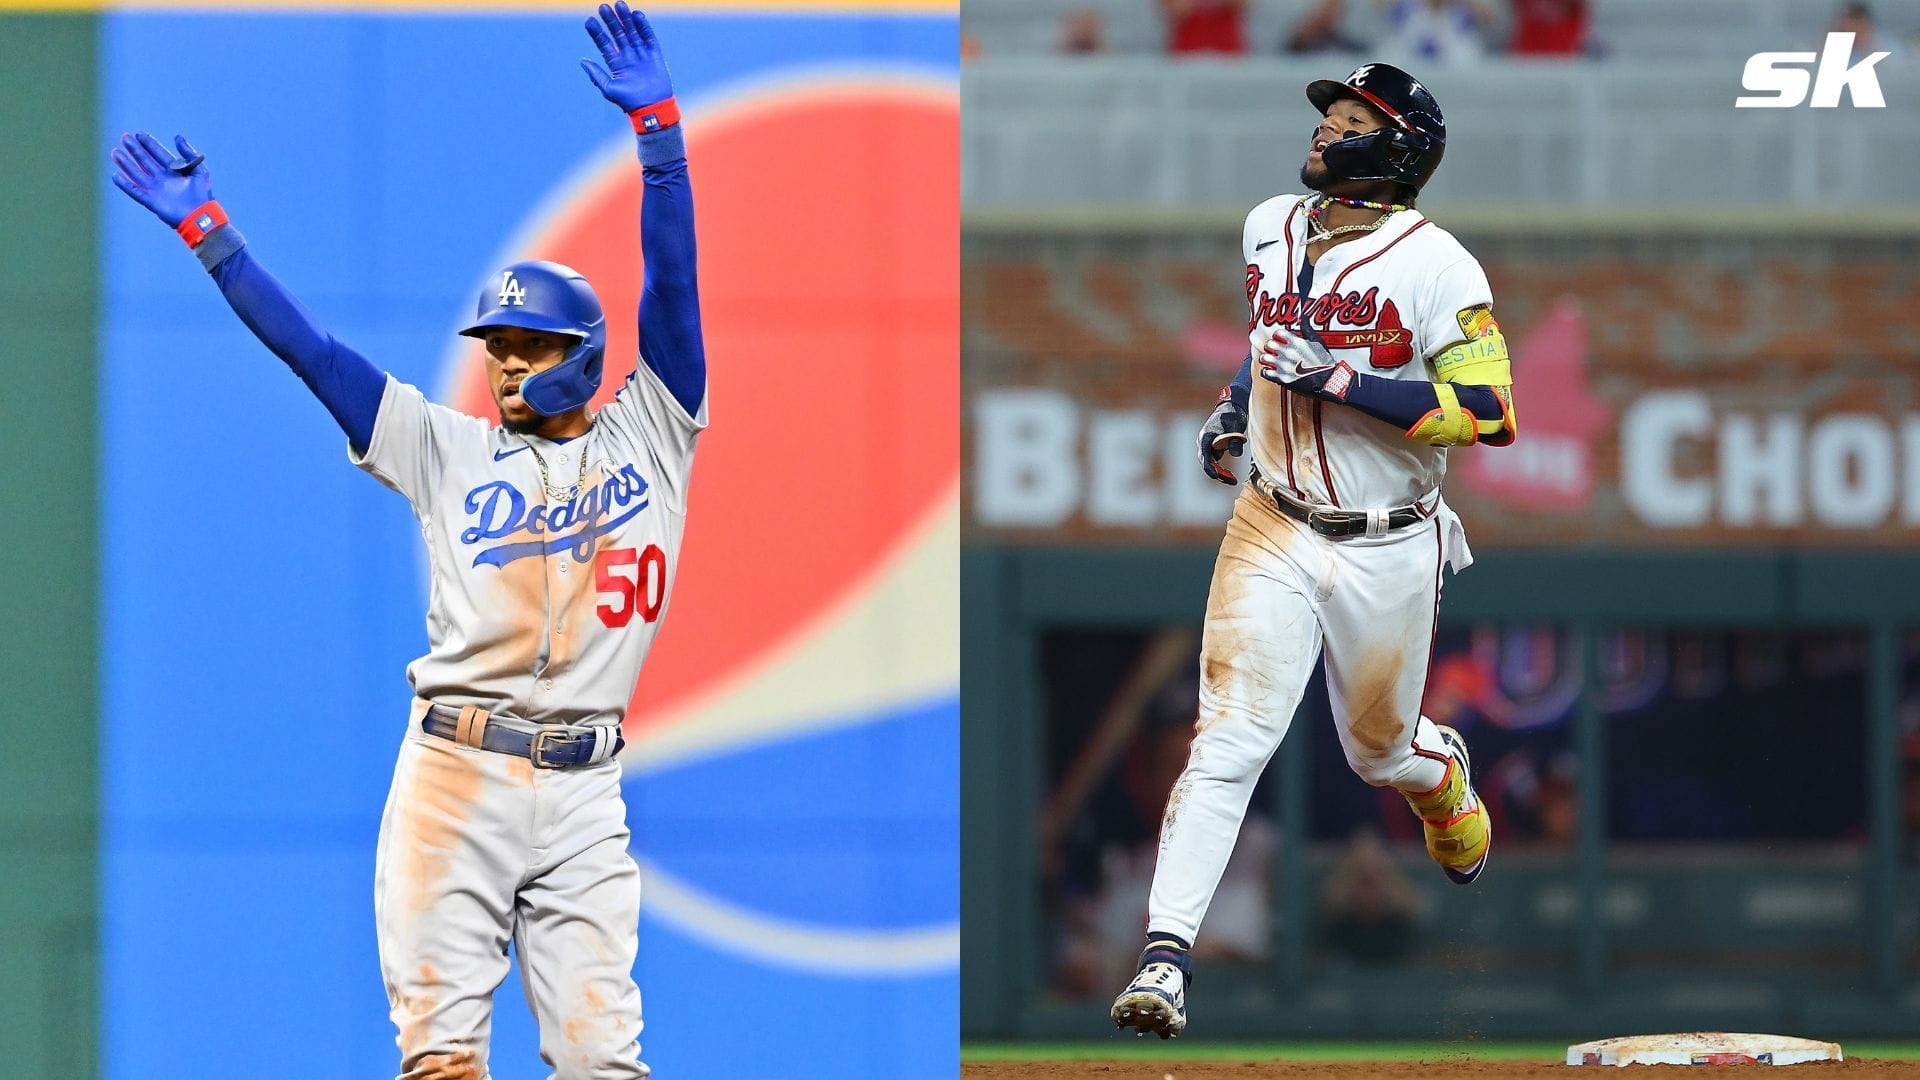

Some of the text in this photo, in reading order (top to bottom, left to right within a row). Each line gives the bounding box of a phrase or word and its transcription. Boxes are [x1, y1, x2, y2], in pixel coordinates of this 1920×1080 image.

[498, 271, 525, 306] LA
[1245, 264, 1379, 332] Braves
[1434, 341, 1497, 369] BESTIA
[973, 390, 1242, 526] BEL
[594, 543, 666, 629] 50
